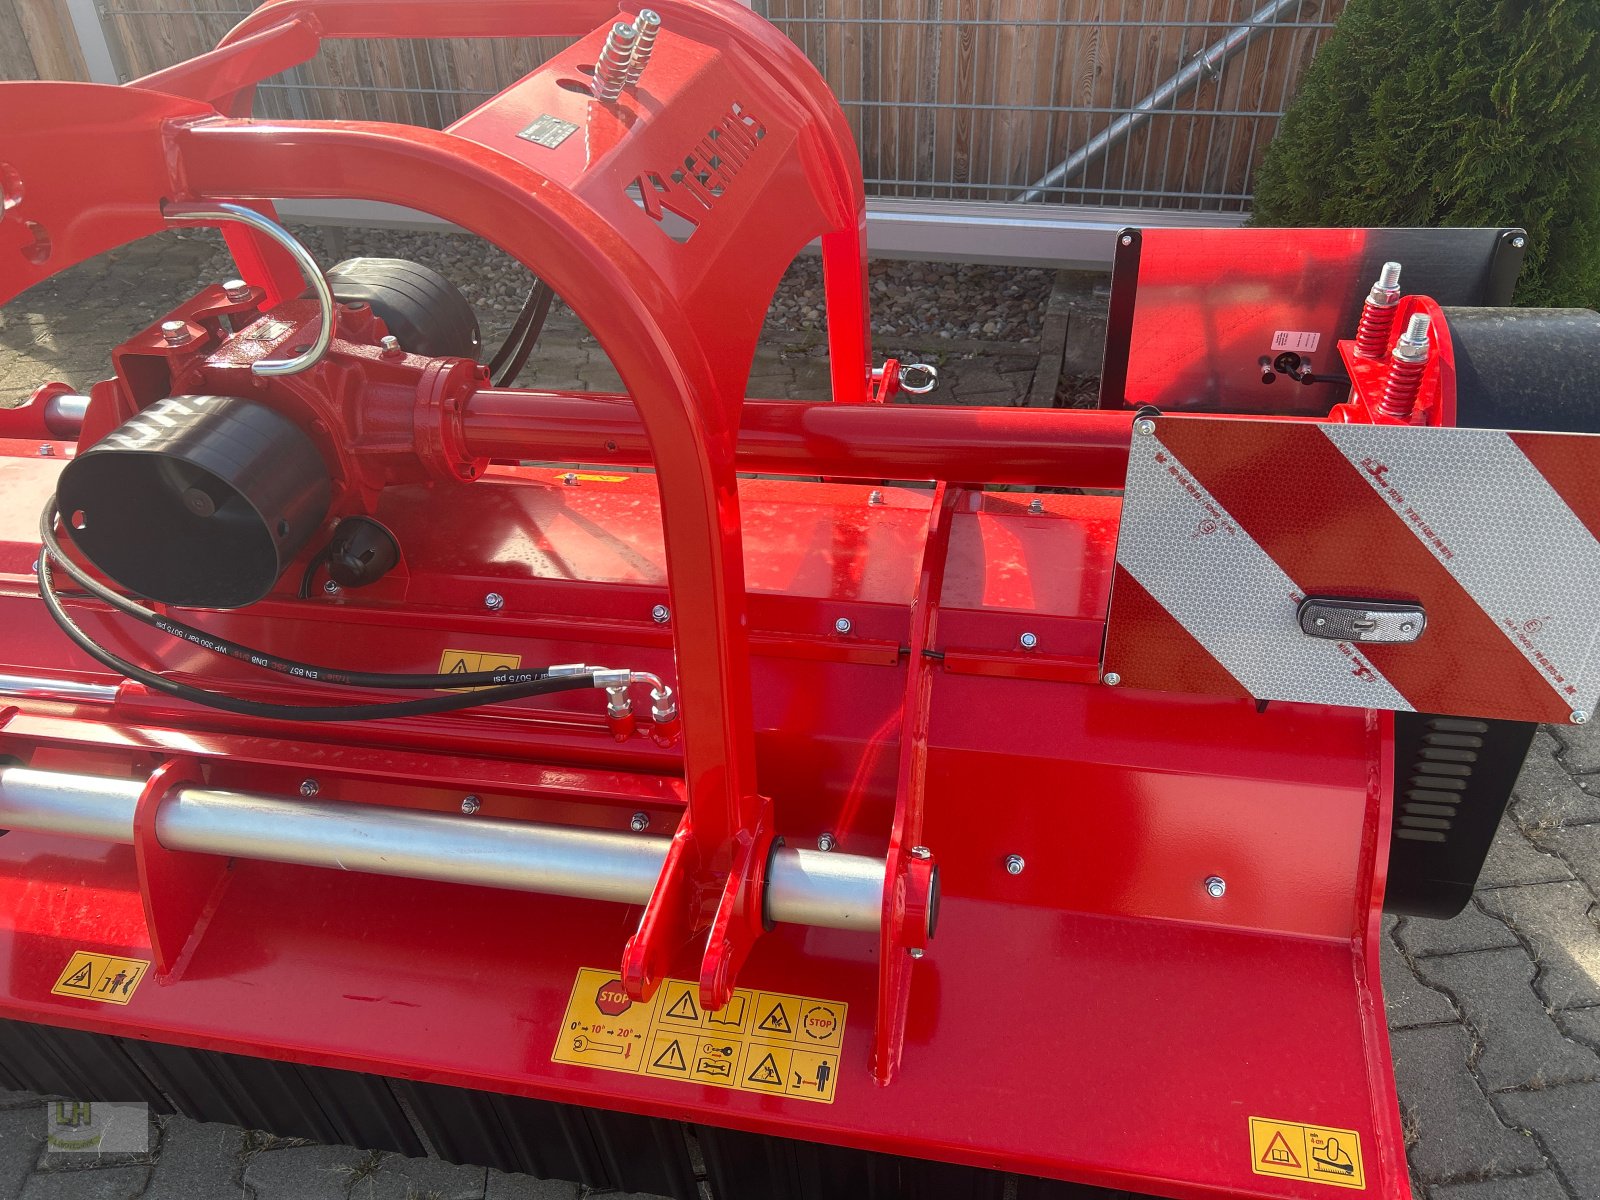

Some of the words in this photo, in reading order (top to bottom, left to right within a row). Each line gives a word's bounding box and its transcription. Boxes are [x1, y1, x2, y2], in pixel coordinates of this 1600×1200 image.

[166, 625, 184, 638] 5075
[187, 634, 200, 645] bar
[200, 639, 214, 649] 350
[214, 644, 227, 655] WP
[251, 655, 268, 667] DN8
[290, 666, 304, 676] 857
[305, 670, 318, 679] EN
[493, 673, 507, 683] psi
[508, 674, 532, 683] 5075
[600, 991, 630, 1004] STOP
[809, 1018, 832, 1028] STOP
